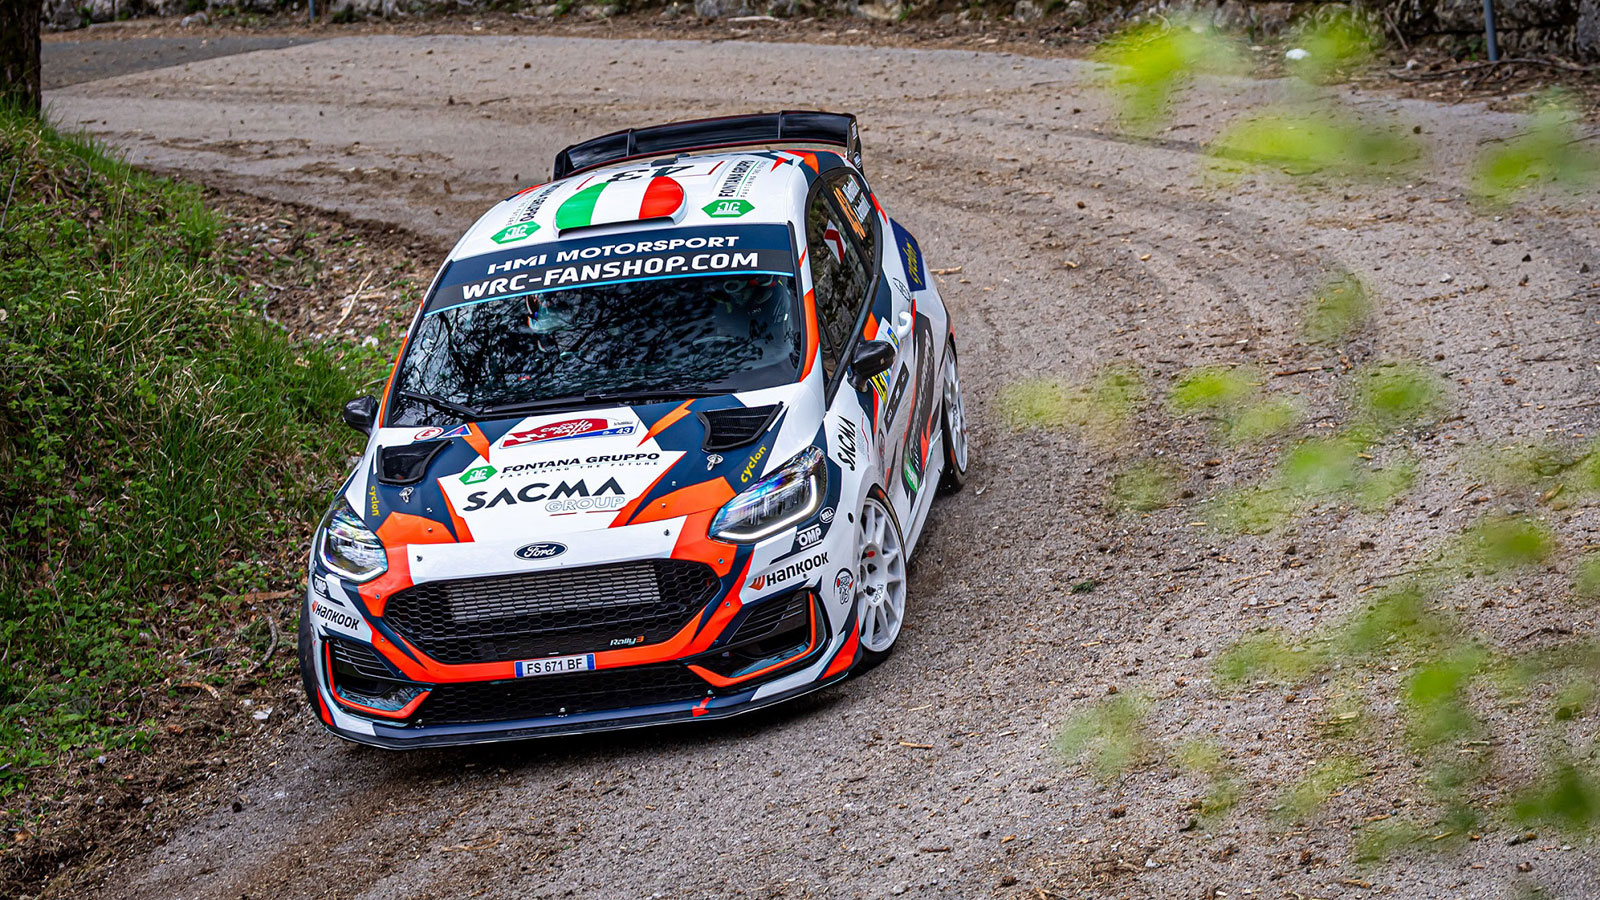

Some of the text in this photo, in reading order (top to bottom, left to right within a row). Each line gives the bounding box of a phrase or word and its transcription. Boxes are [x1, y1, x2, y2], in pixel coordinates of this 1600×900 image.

[487, 236, 739, 275] HMI MOTORSPORT
[462, 252, 758, 300] WRC-FANSHOP.COM
[615, 426, 632, 435] 43
[837, 415, 857, 472] SACMA
[501, 452, 661, 474] FONTANA GRUPPO
[741, 446, 765, 483] cyclon
[369, 485, 380, 516] cyclon
[462, 477, 626, 512] SACMA
[545, 496, 626, 513] GROUP
[798, 529, 822, 546] OMP
[523, 544, 556, 558] Ford
[526, 658, 583, 675] FS 671 BF
